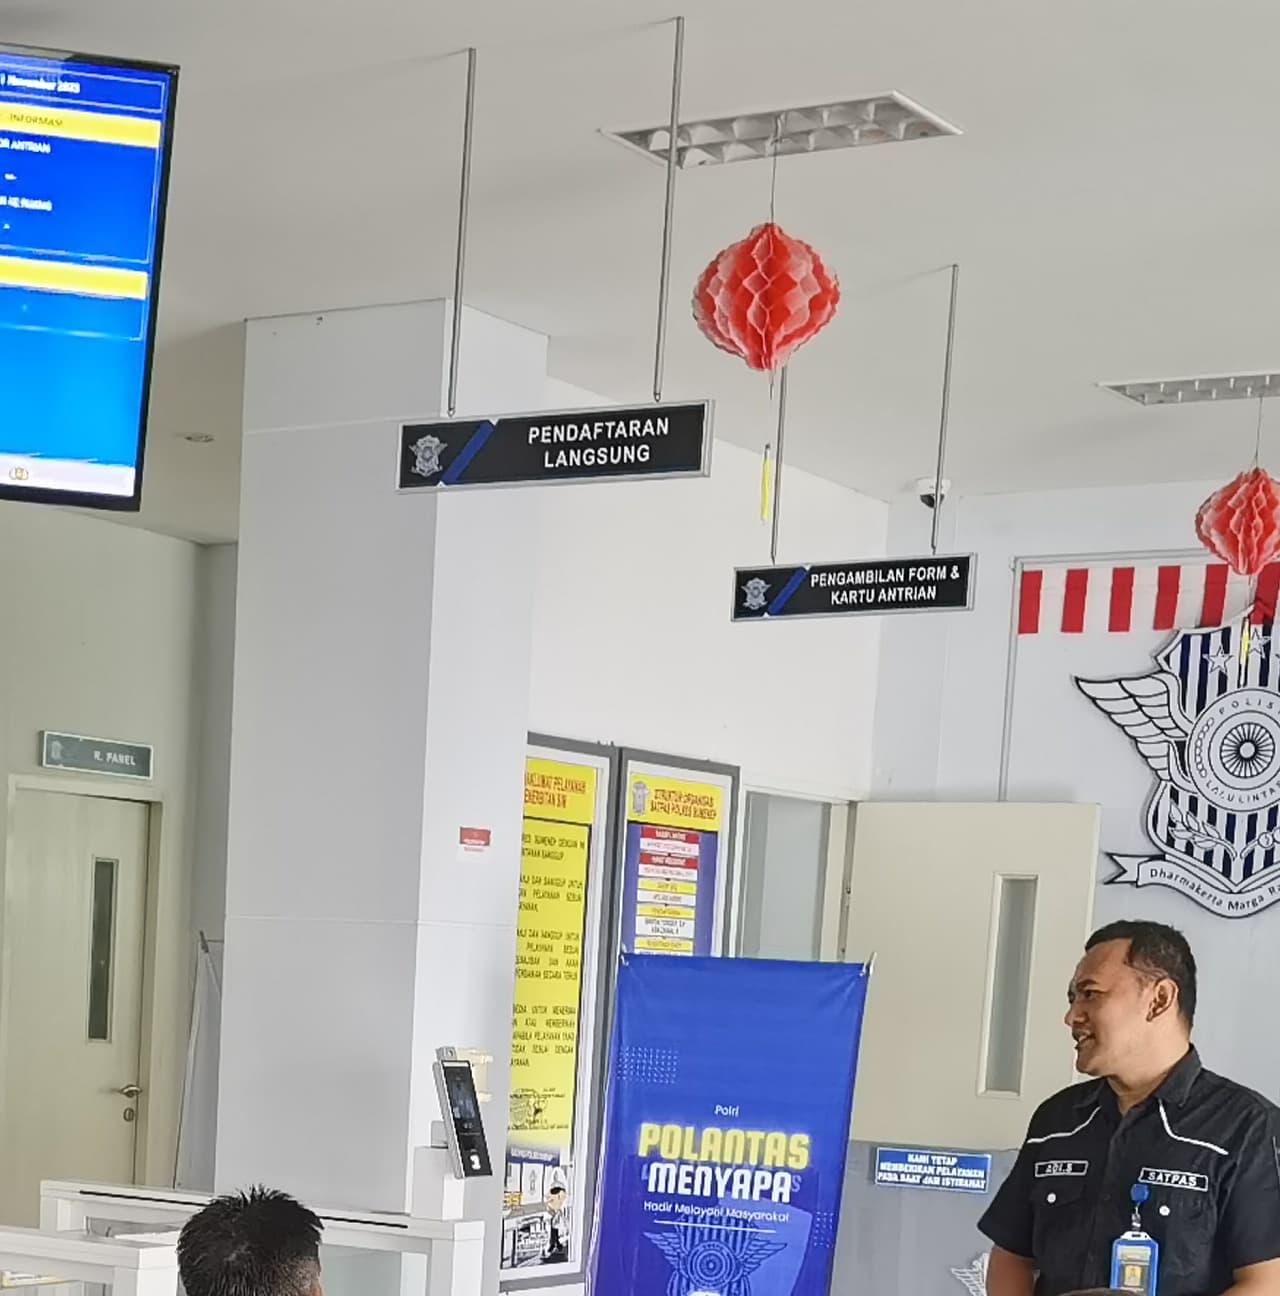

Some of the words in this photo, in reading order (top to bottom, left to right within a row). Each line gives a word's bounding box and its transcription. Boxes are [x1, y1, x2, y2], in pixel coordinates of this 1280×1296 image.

[528, 417, 669, 444] PENDAFTARAN
[544, 444, 651, 468] LANGSUNG
[810, 568, 905, 587] PENGAMBILAN
[908, 566, 947, 582] FORM
[950, 565, 960, 579] &
[831, 588, 875, 605] KARTU
[878, 585, 936, 603] ANTRIAN
[106, 752, 136, 766] PANEL
[523, 788, 556, 807] ENERBITAN
[1149, 868, 1223, 907] Dharmakerta
[1227, 894, 1265, 911] Marga
[714, 1104, 739, 1117] Polri
[638, 1122, 810, 1170] POLANTAS
[907, 1153, 929, 1164] KAMI
[931, 1156, 958, 1166] TETAP
[648, 1162, 792, 1203] MENYAPA
[878, 1171, 899, 1181] PADA
[900, 1173, 921, 1184] SAAT
[922, 1175, 940, 1185] JAM
[941, 1177, 986, 1189] ISTIRAHAT
[1148, 1171, 1197, 1187] SATPAS
[644, 1200, 672, 1212] Hadir
[675, 1203, 723, 1217] Melayani
[726, 1207, 789, 1223] Masyarakat
